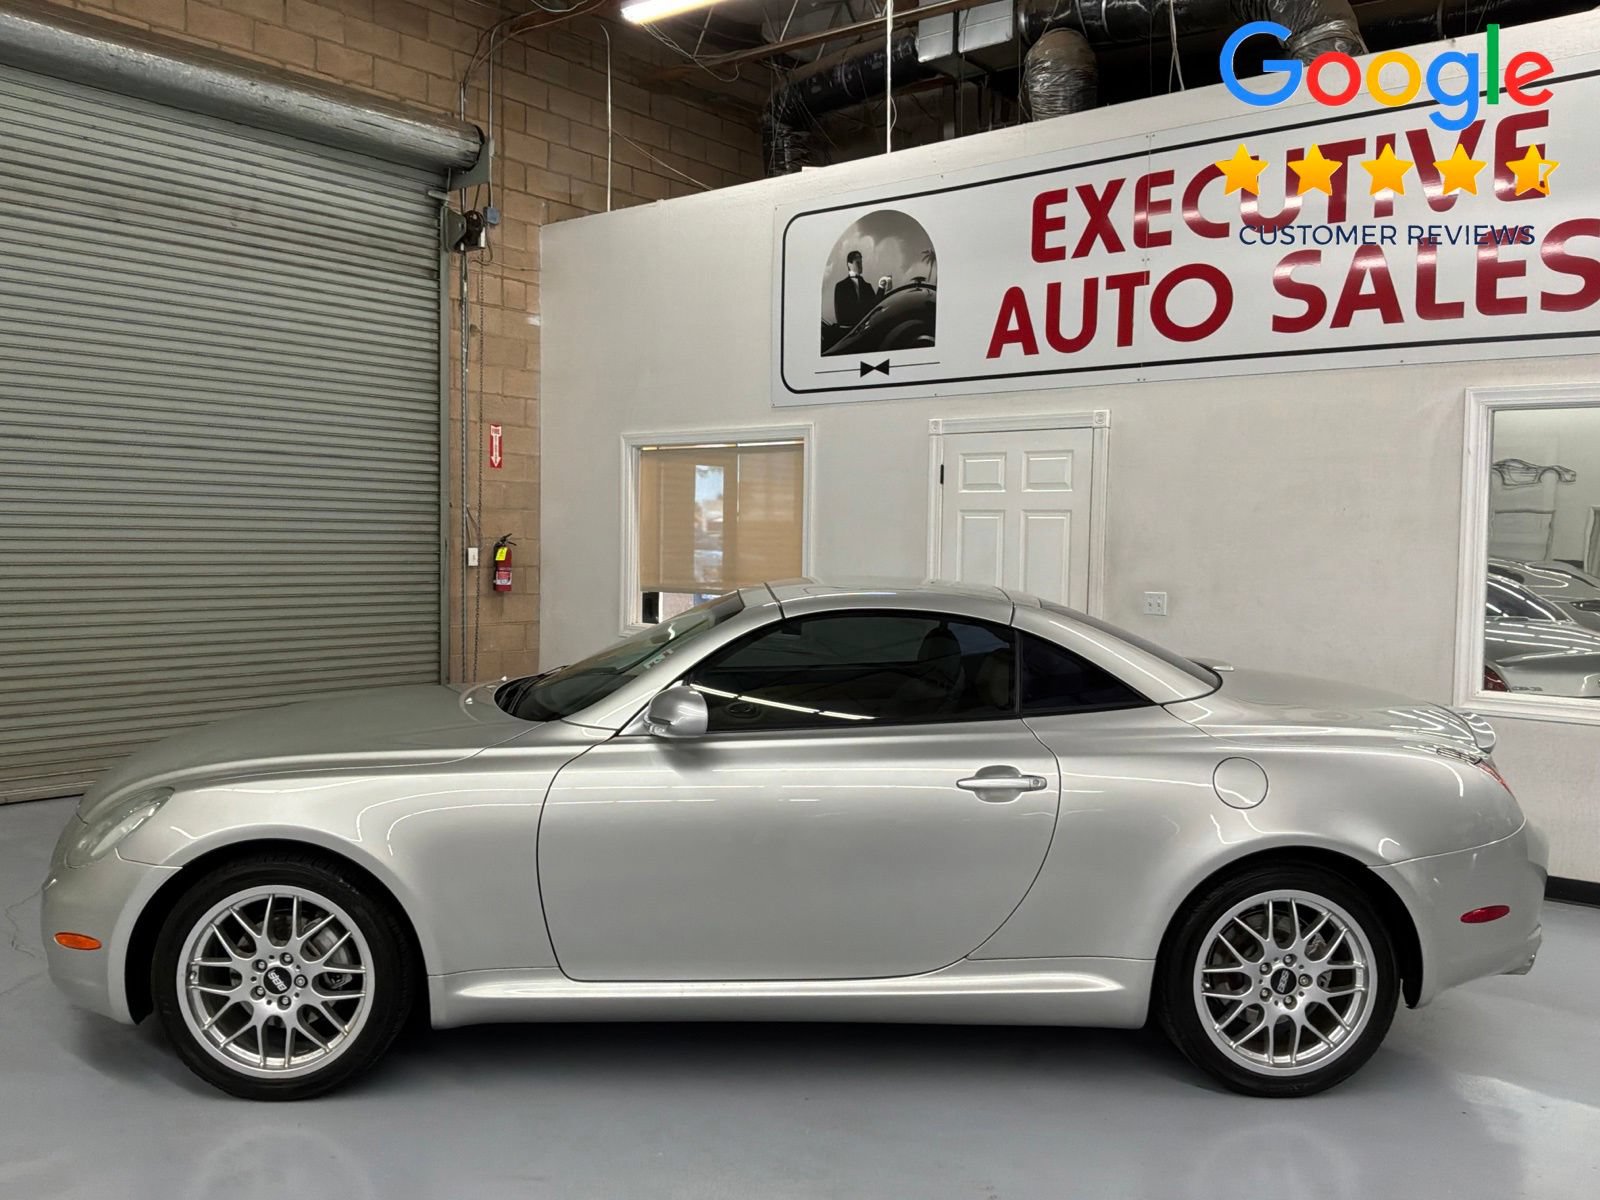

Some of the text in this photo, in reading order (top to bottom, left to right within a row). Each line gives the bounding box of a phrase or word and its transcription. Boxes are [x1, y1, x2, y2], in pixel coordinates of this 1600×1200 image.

[1031, 109, 1550, 264] EXECUTIVE
[985, 217, 1600, 359] AUTO SALES
